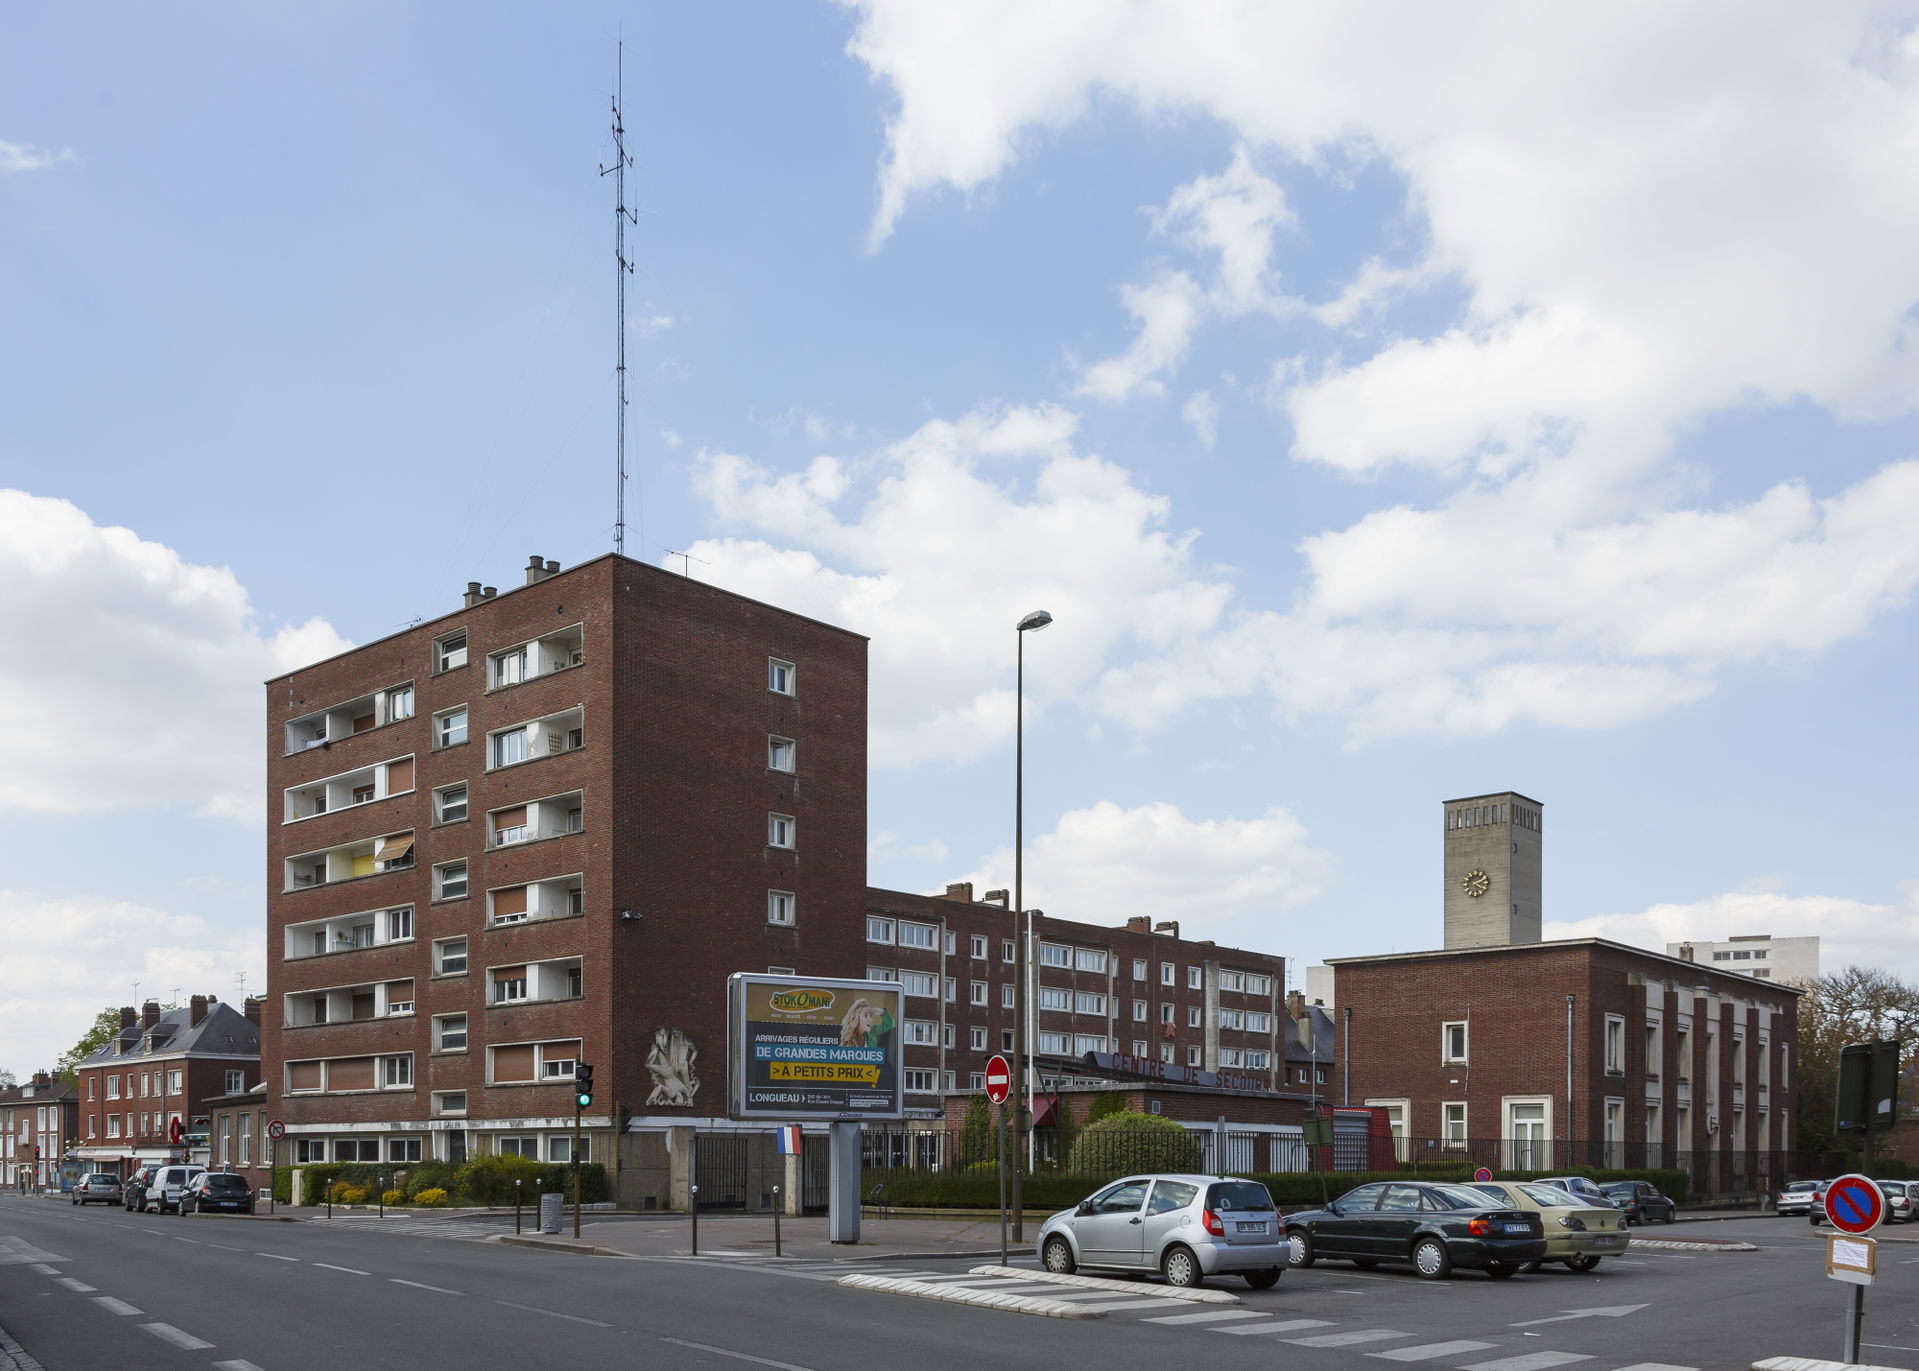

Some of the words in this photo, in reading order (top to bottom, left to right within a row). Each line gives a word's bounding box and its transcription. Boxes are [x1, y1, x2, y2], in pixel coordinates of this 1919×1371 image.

[774, 992, 830, 1007] STOKOMANI
[755, 1034, 798, 1044] ARRIVAGES
[799, 1035, 839, 1045] RÉGULIERS
[756, 1046, 771, 1058] DE
[774, 1047, 827, 1060] GRANDES
[829, 1050, 884, 1062] MARQUES
[794, 1065, 835, 1078] PETITS
[837, 1067, 864, 1079] PRIX
[1112, 1052, 1166, 1079] CENTRE
[1183, 1066, 1199, 1084] DE
[1216, 1071, 1270, 1092] SECOURS
[749, 1092, 800, 1103] LONGUEAU
